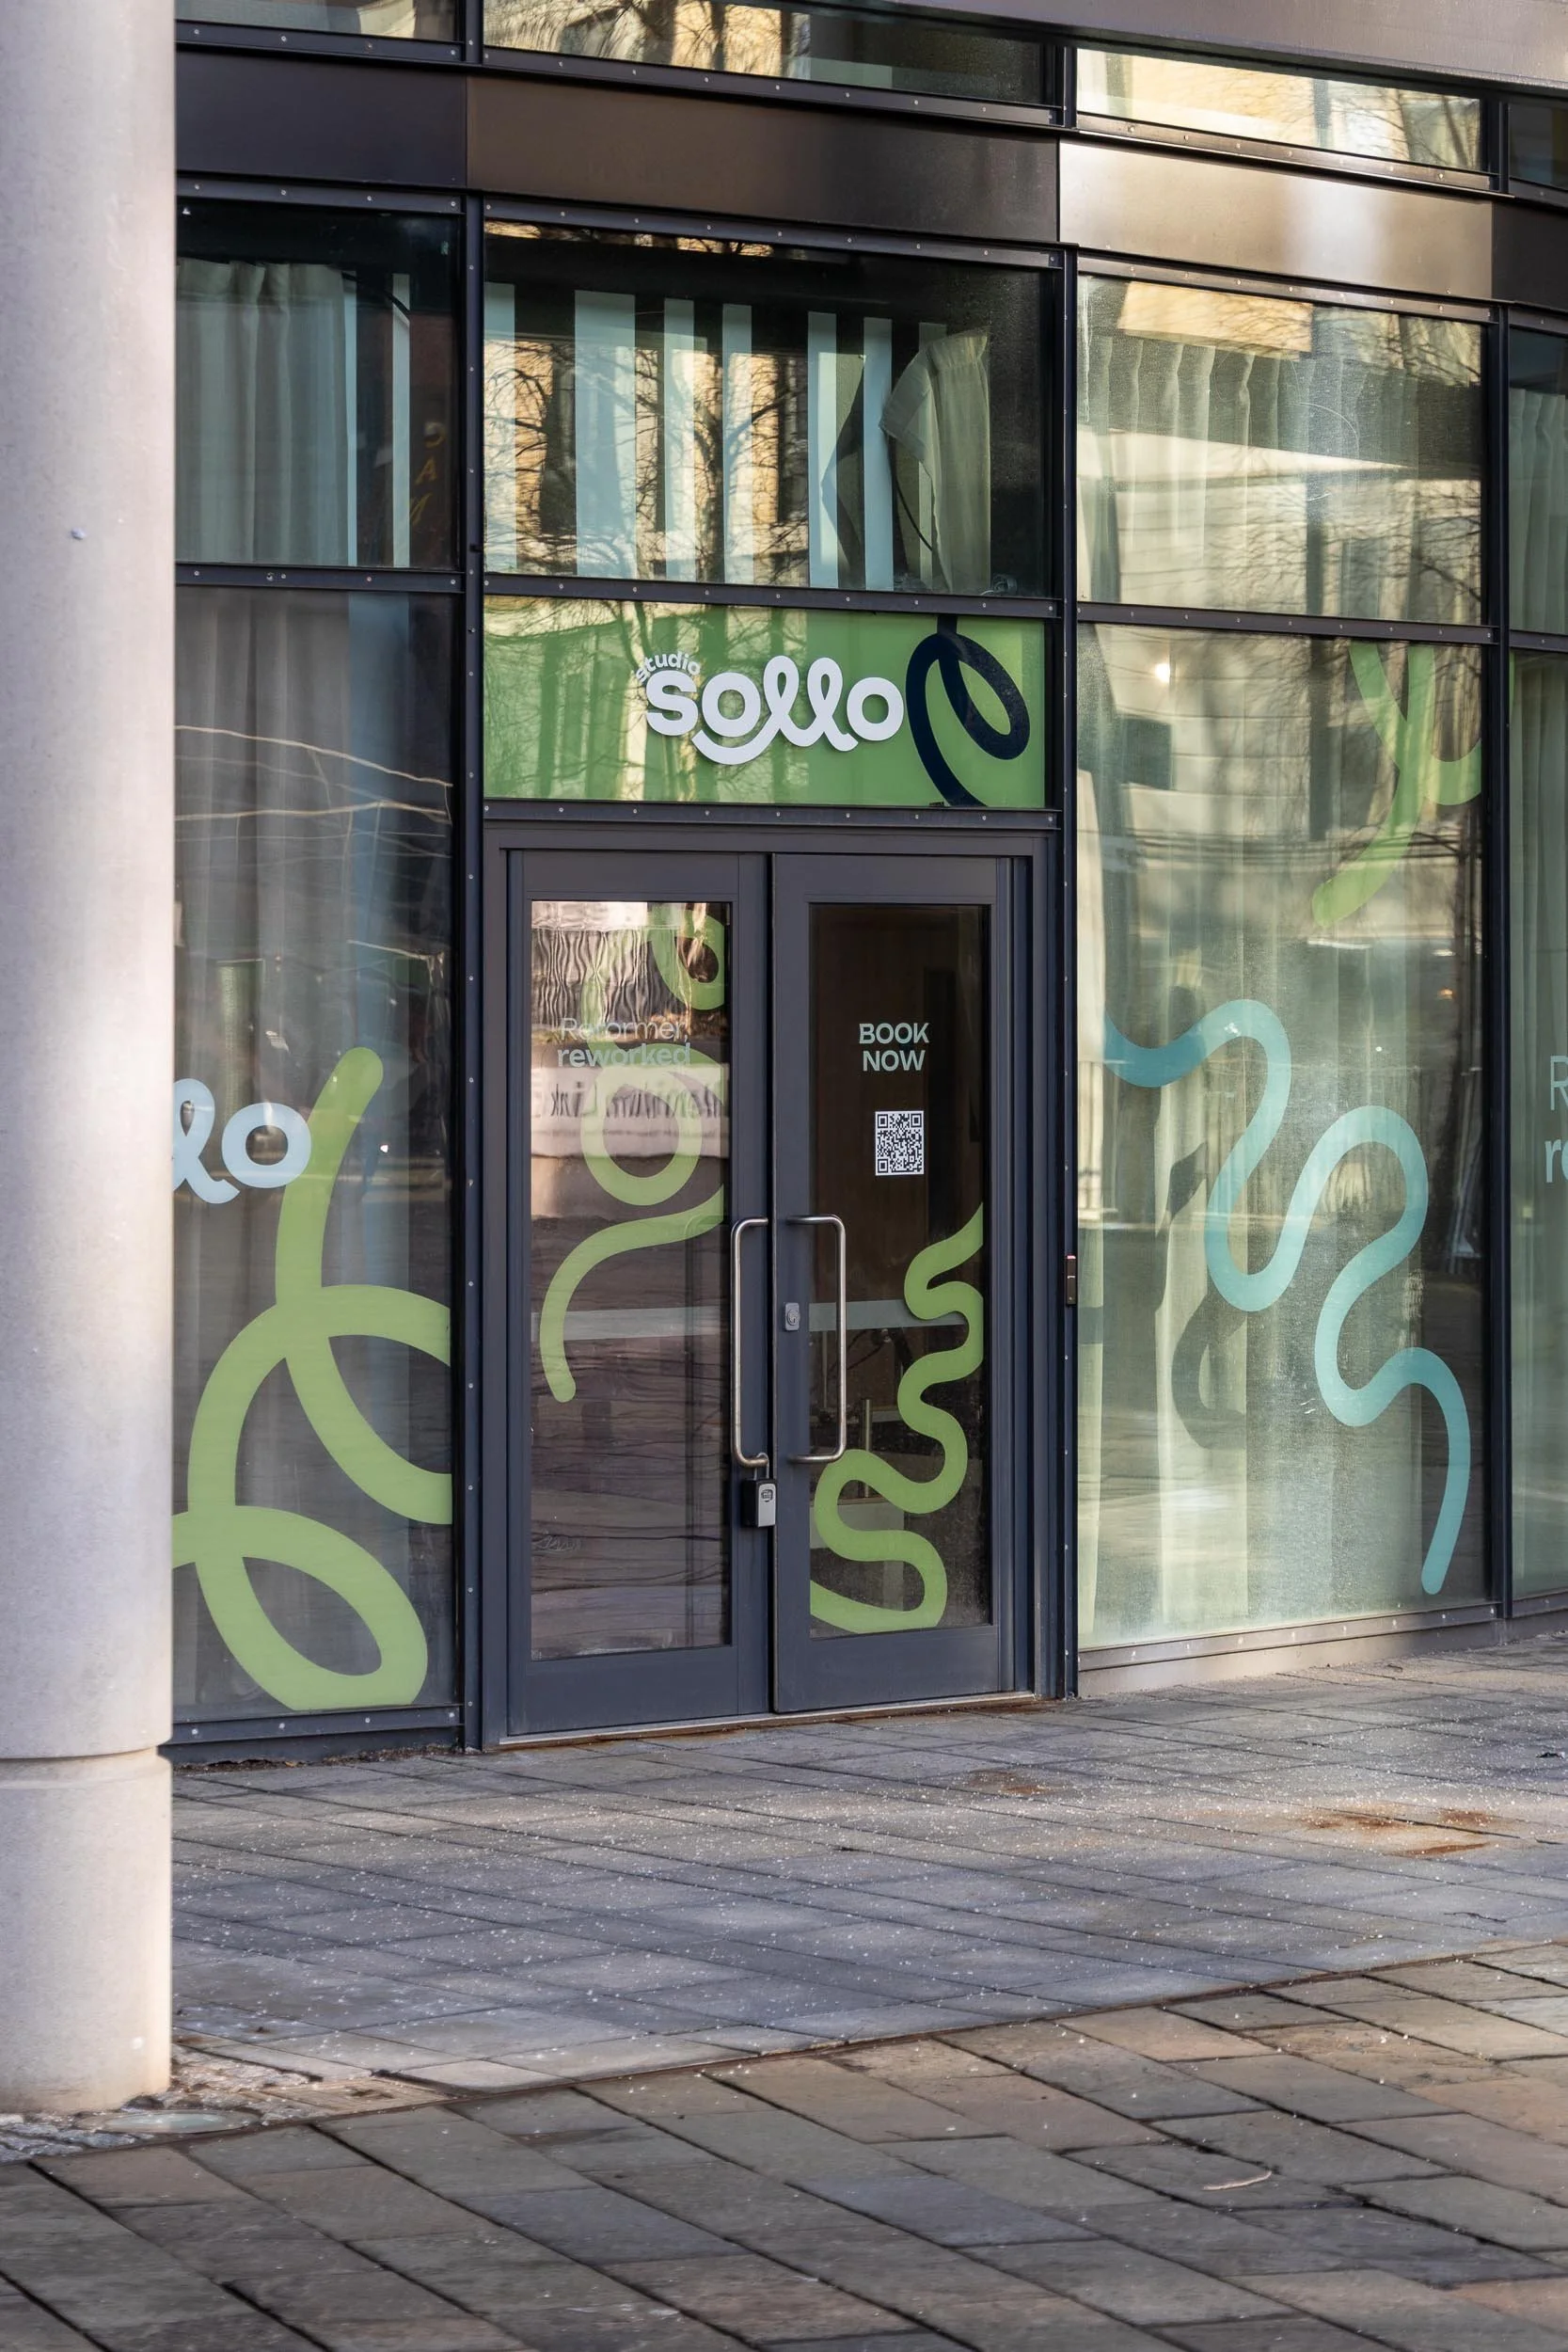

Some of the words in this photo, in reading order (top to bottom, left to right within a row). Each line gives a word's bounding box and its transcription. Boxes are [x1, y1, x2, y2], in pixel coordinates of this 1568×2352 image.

[636, 651, 701, 683] studio
[645, 655, 904, 765] sollo
[859, 1023, 929, 1044] BOOK
[557, 1042, 691, 1068] reworked
[863, 1050, 926, 1072] NOW
